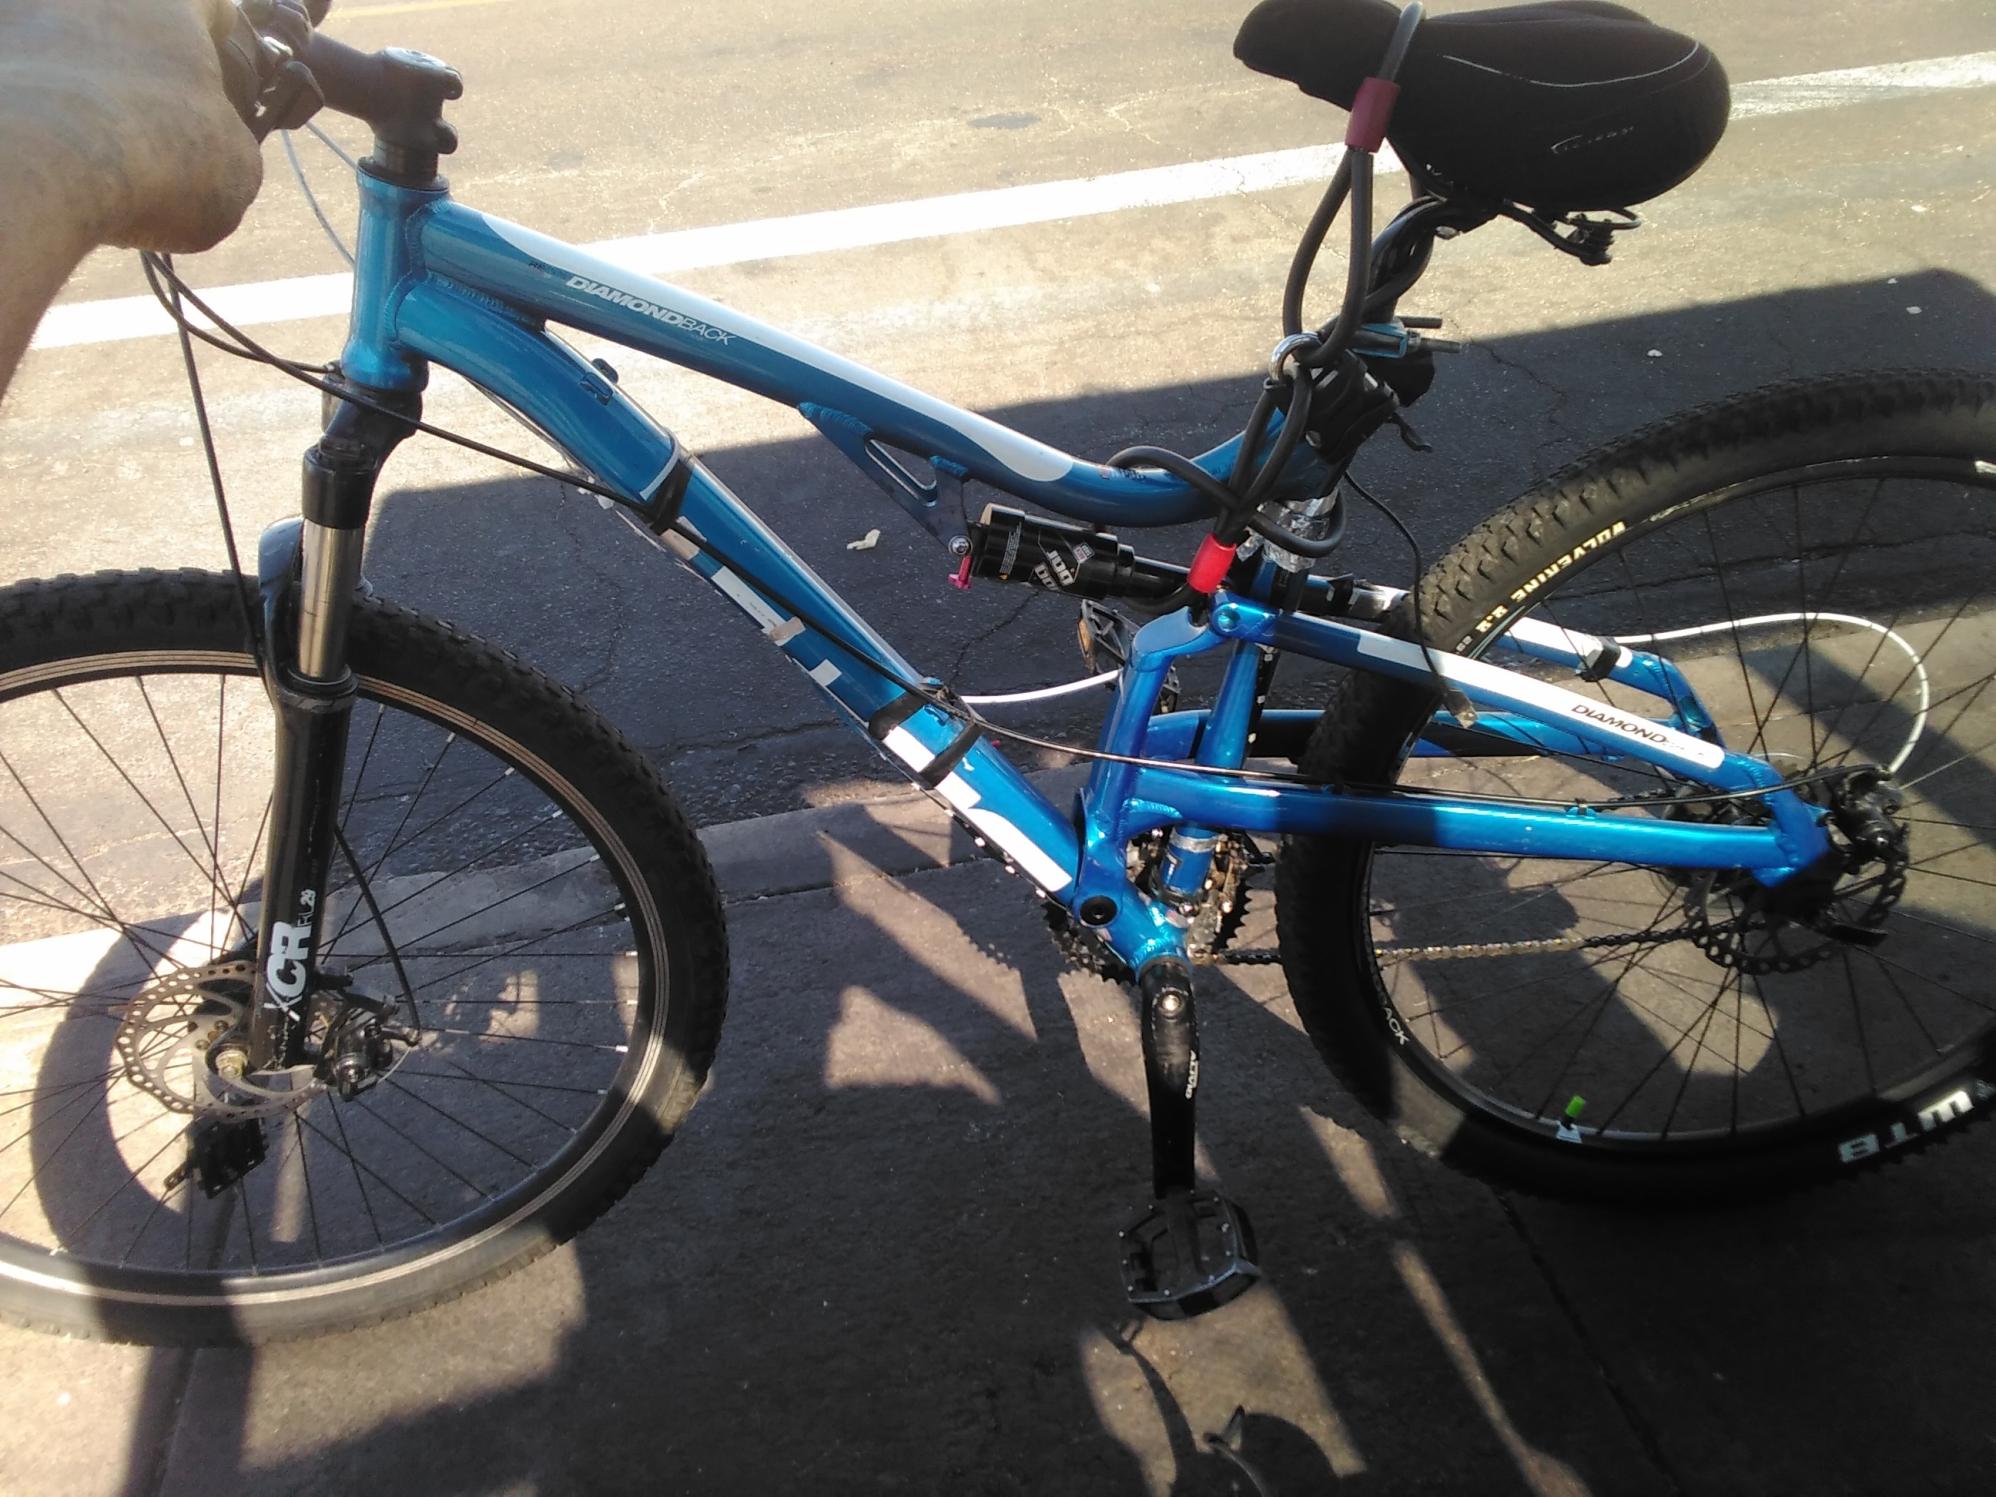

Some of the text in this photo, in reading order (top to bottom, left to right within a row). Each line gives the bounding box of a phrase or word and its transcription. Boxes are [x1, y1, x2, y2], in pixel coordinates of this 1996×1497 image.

[566, 276, 736, 345] DIAMONDBACK
[1509, 520, 1627, 603] WOLVERINE
[263, 921, 312, 1022] XCR
[1838, 1090, 1974, 1163] WTB
